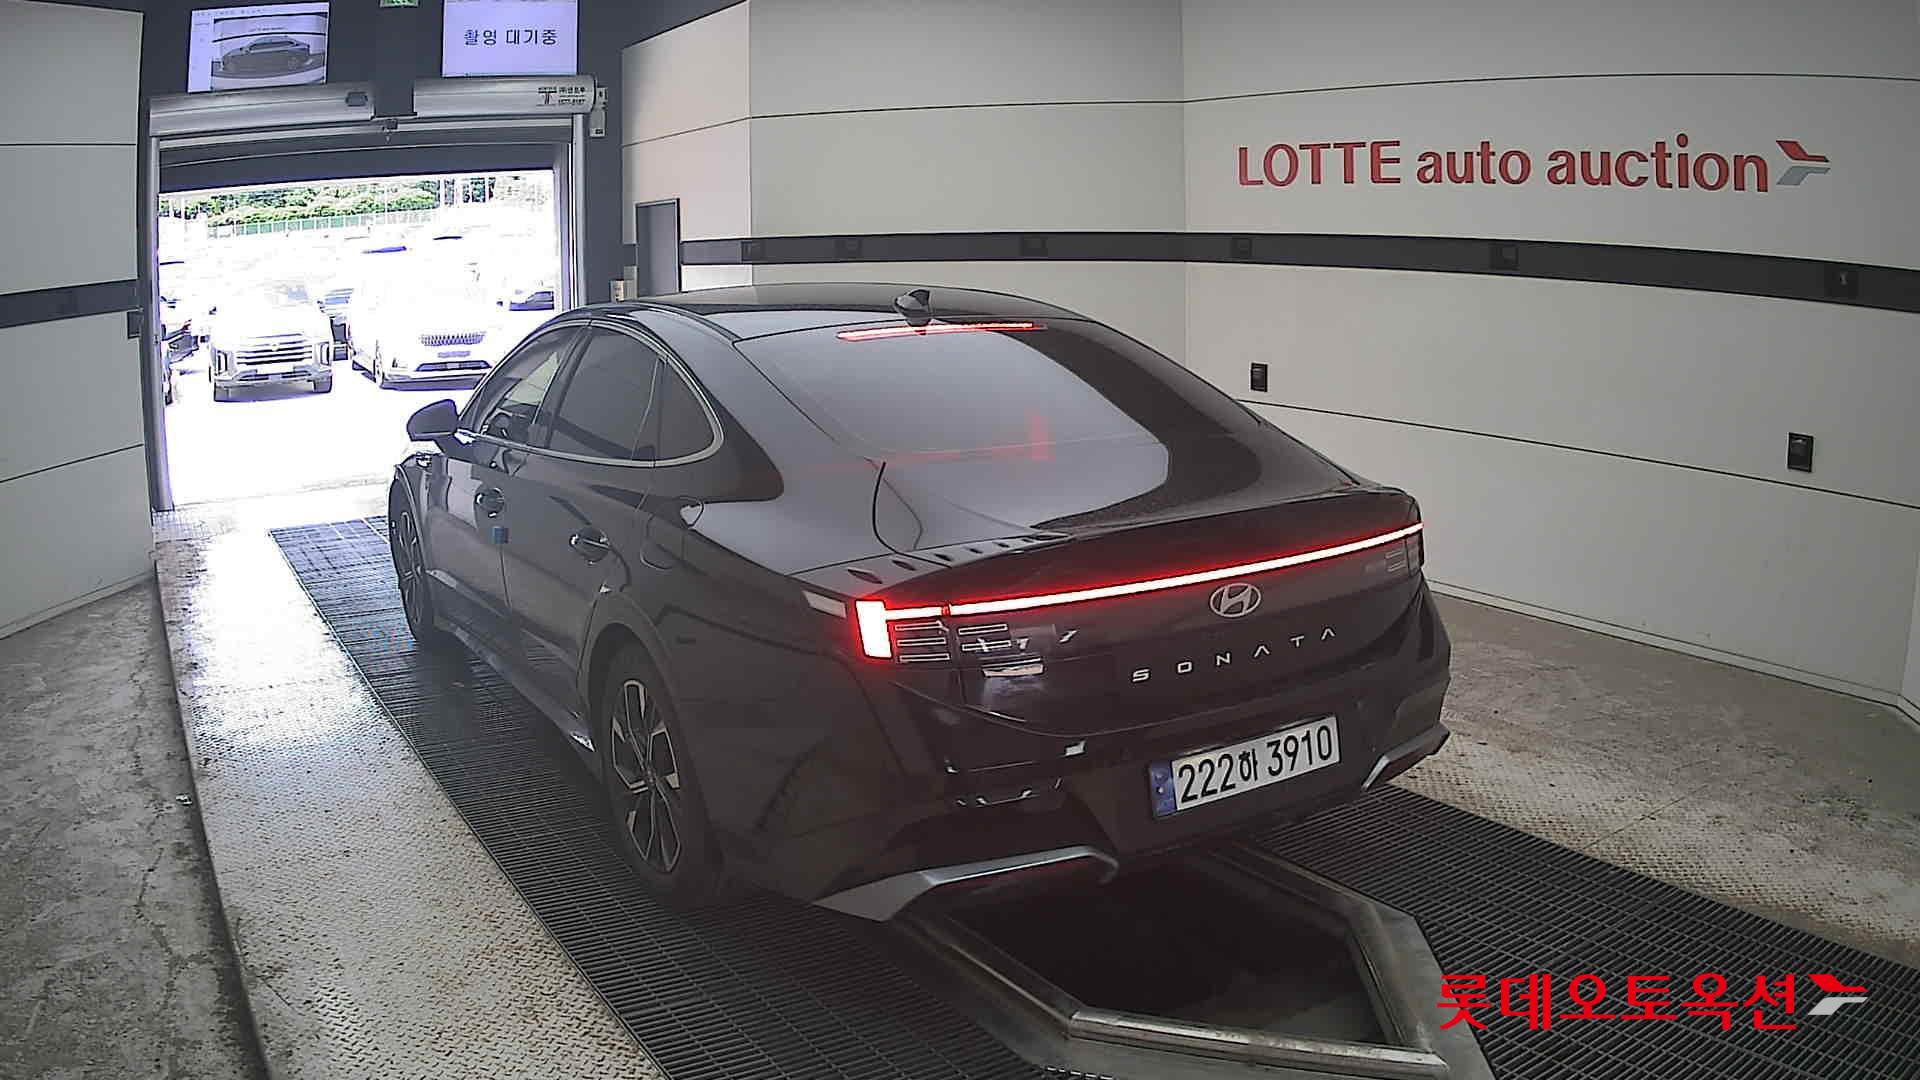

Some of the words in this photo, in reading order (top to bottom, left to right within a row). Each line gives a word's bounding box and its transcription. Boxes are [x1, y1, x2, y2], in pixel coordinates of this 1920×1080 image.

[463, 29, 497, 46] 촬영
[505, 29, 558, 46] 대기중
[1238, 140, 1401, 187] LOTTE
[1416, 140, 1532, 185] auto
[1547, 132, 1769, 193] auction
[1131, 627, 1336, 683] SONATA
[1177, 747, 1259, 804] 222하
[1266, 724, 1333, 778] 3910
